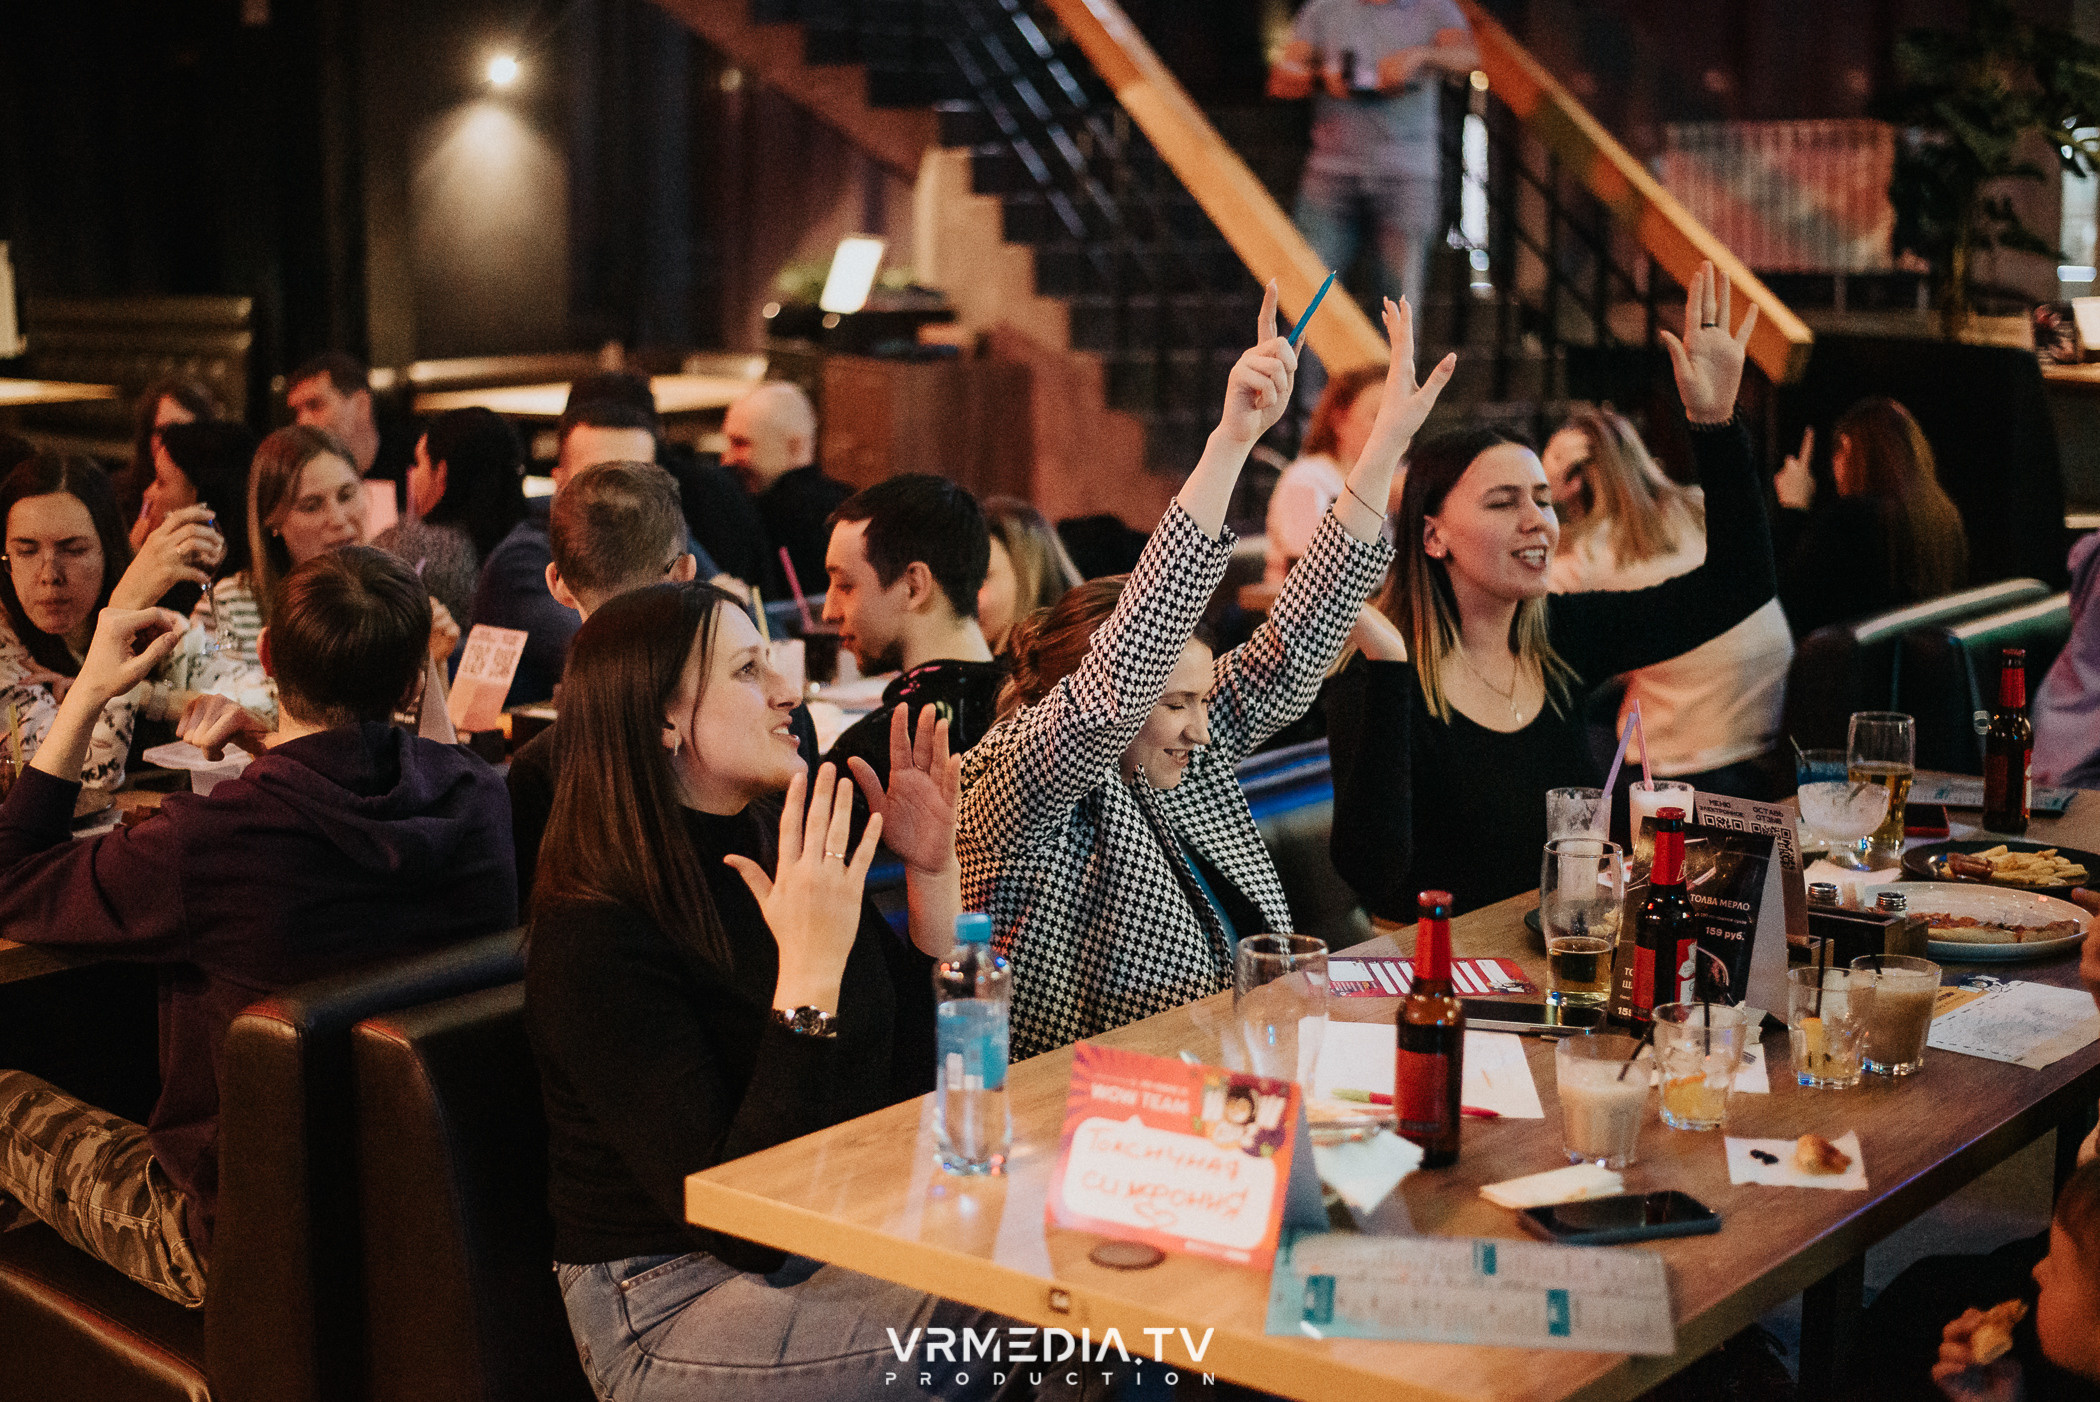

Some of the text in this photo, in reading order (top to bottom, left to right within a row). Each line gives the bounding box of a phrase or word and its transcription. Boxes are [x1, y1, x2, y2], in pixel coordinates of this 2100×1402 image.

[1708, 799, 1731, 809] МЕНЮ
[1752, 806, 1784, 818] ОСТАВЬ
[1755, 814, 1783, 825] ОТЗЫВ
[1720, 899, 1751, 911] МЕРЛО
[1705, 926, 1745, 941] 159 руб.
[1142, 1091, 1190, 1116] TEAM
